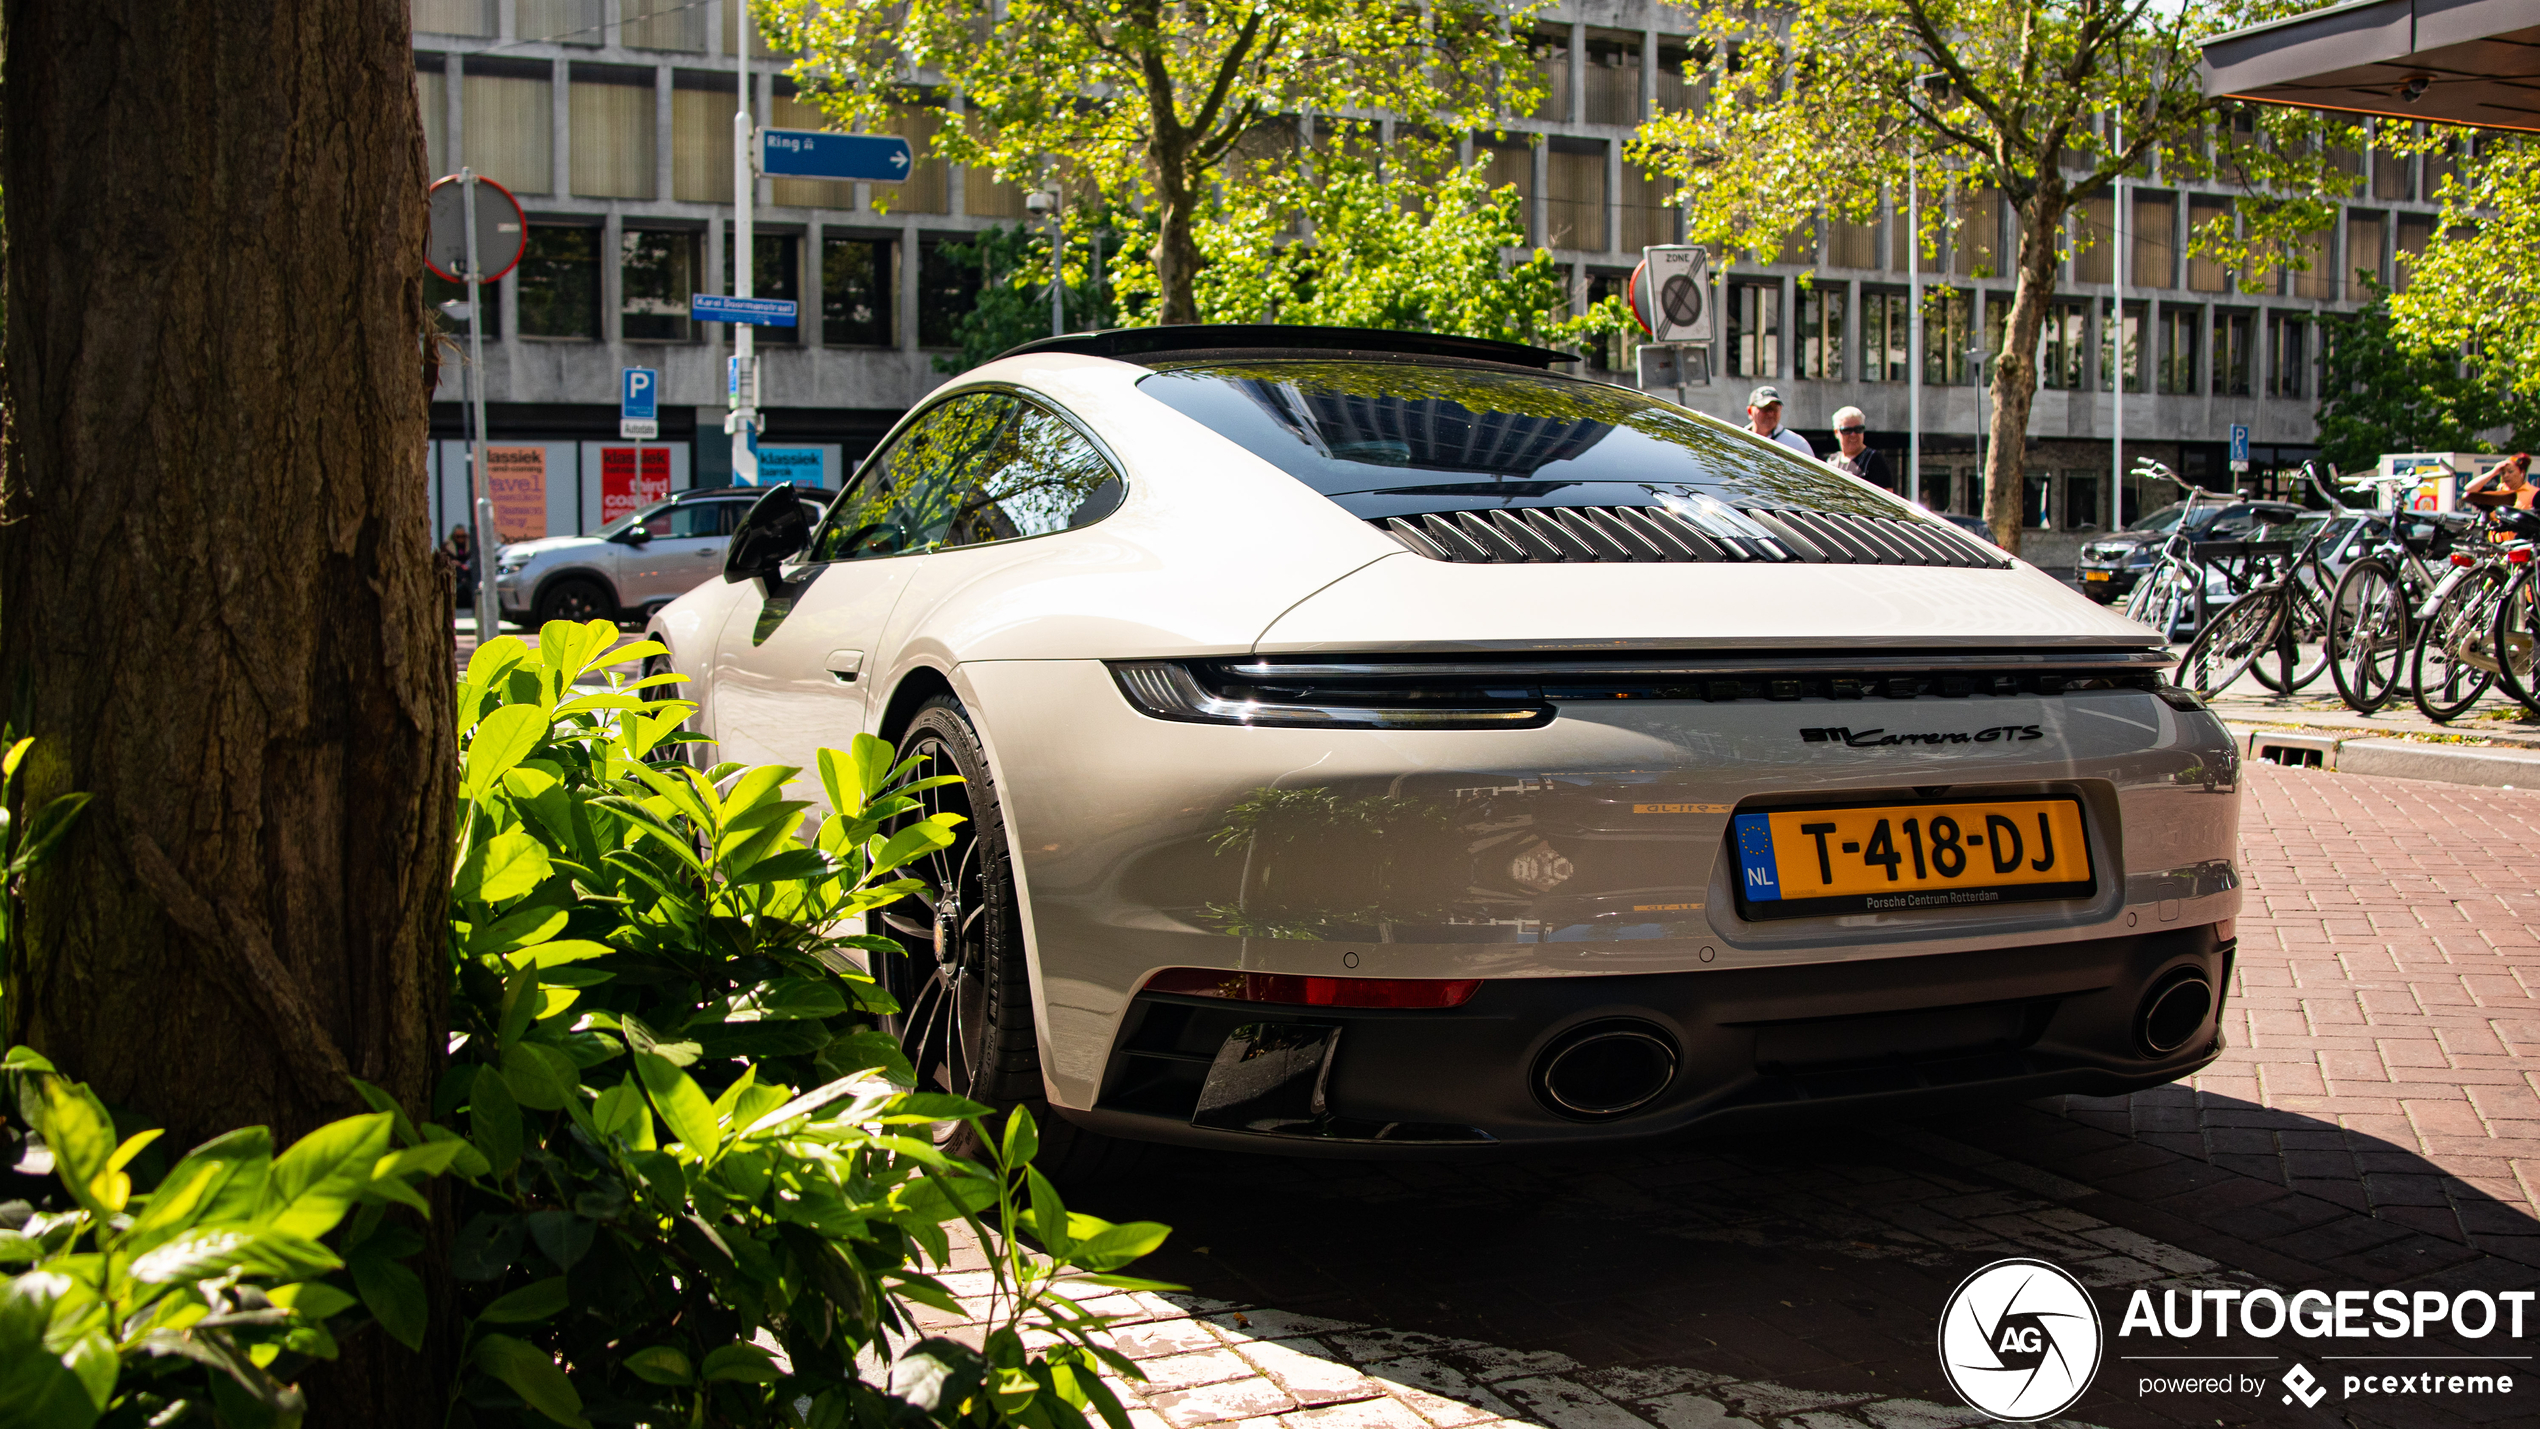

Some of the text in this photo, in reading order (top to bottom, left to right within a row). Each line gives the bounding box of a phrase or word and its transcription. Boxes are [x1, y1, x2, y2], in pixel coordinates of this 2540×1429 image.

[767, 135, 800, 152] Ring
[1666, 253, 1690, 263] ZONE
[630, 372, 649, 399] P
[2235, 428, 2246, 446] P
[486, 450, 542, 464] lassiek
[760, 452, 820, 466] klassiek
[1799, 724, 2044, 747] 911 Carrera GTS
[1800, 811, 2056, 885] T-418-DJ
[1747, 867, 1774, 887] NL
[1866, 889, 1999, 909] Porsche Centrum Rotterdam
[989, 884, 999, 1019] MICHELIN
